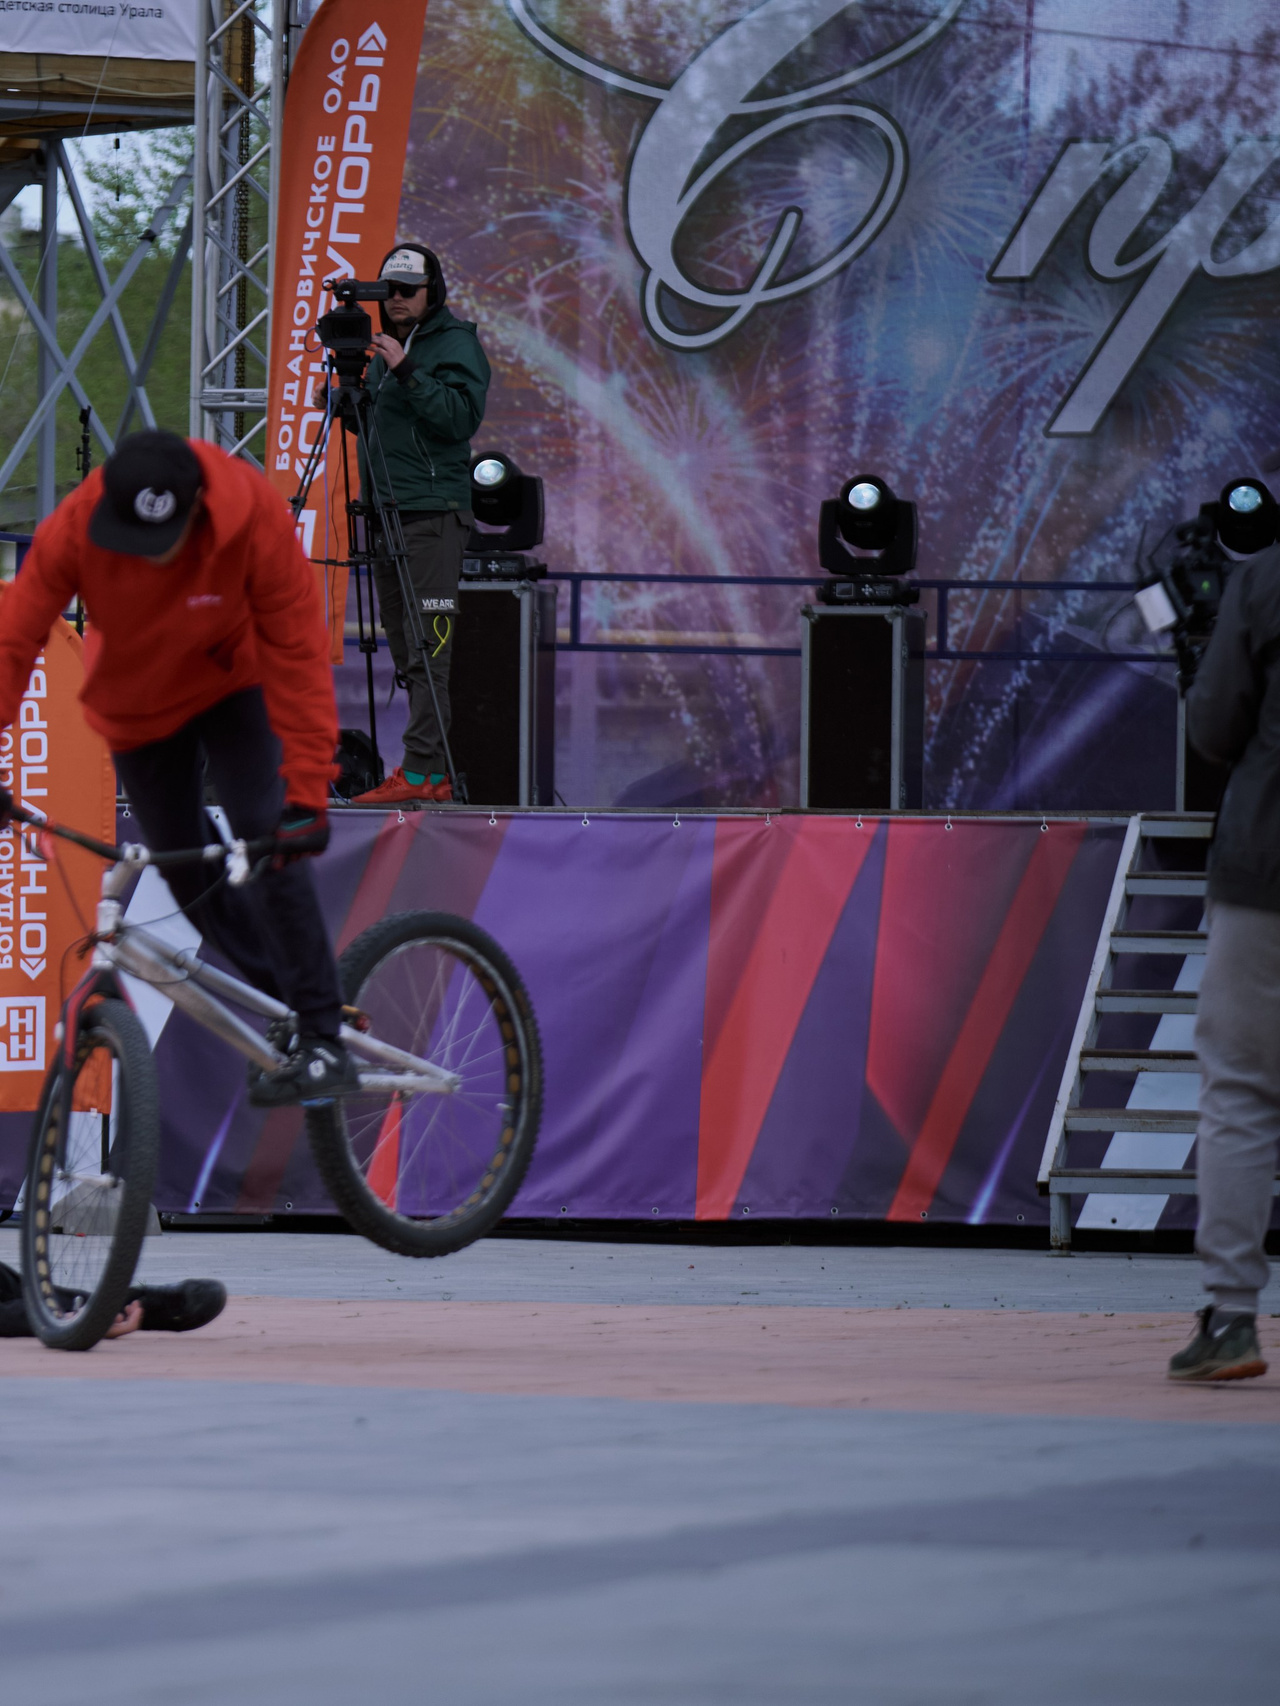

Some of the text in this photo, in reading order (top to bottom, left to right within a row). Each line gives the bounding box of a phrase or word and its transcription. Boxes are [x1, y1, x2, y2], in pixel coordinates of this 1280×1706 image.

[57, 2, 116, 16] столица
[119, 3, 164, 19] Урала
[275, 38, 351, 471] БОГДАНОВИЧСКОЕ ОАО
